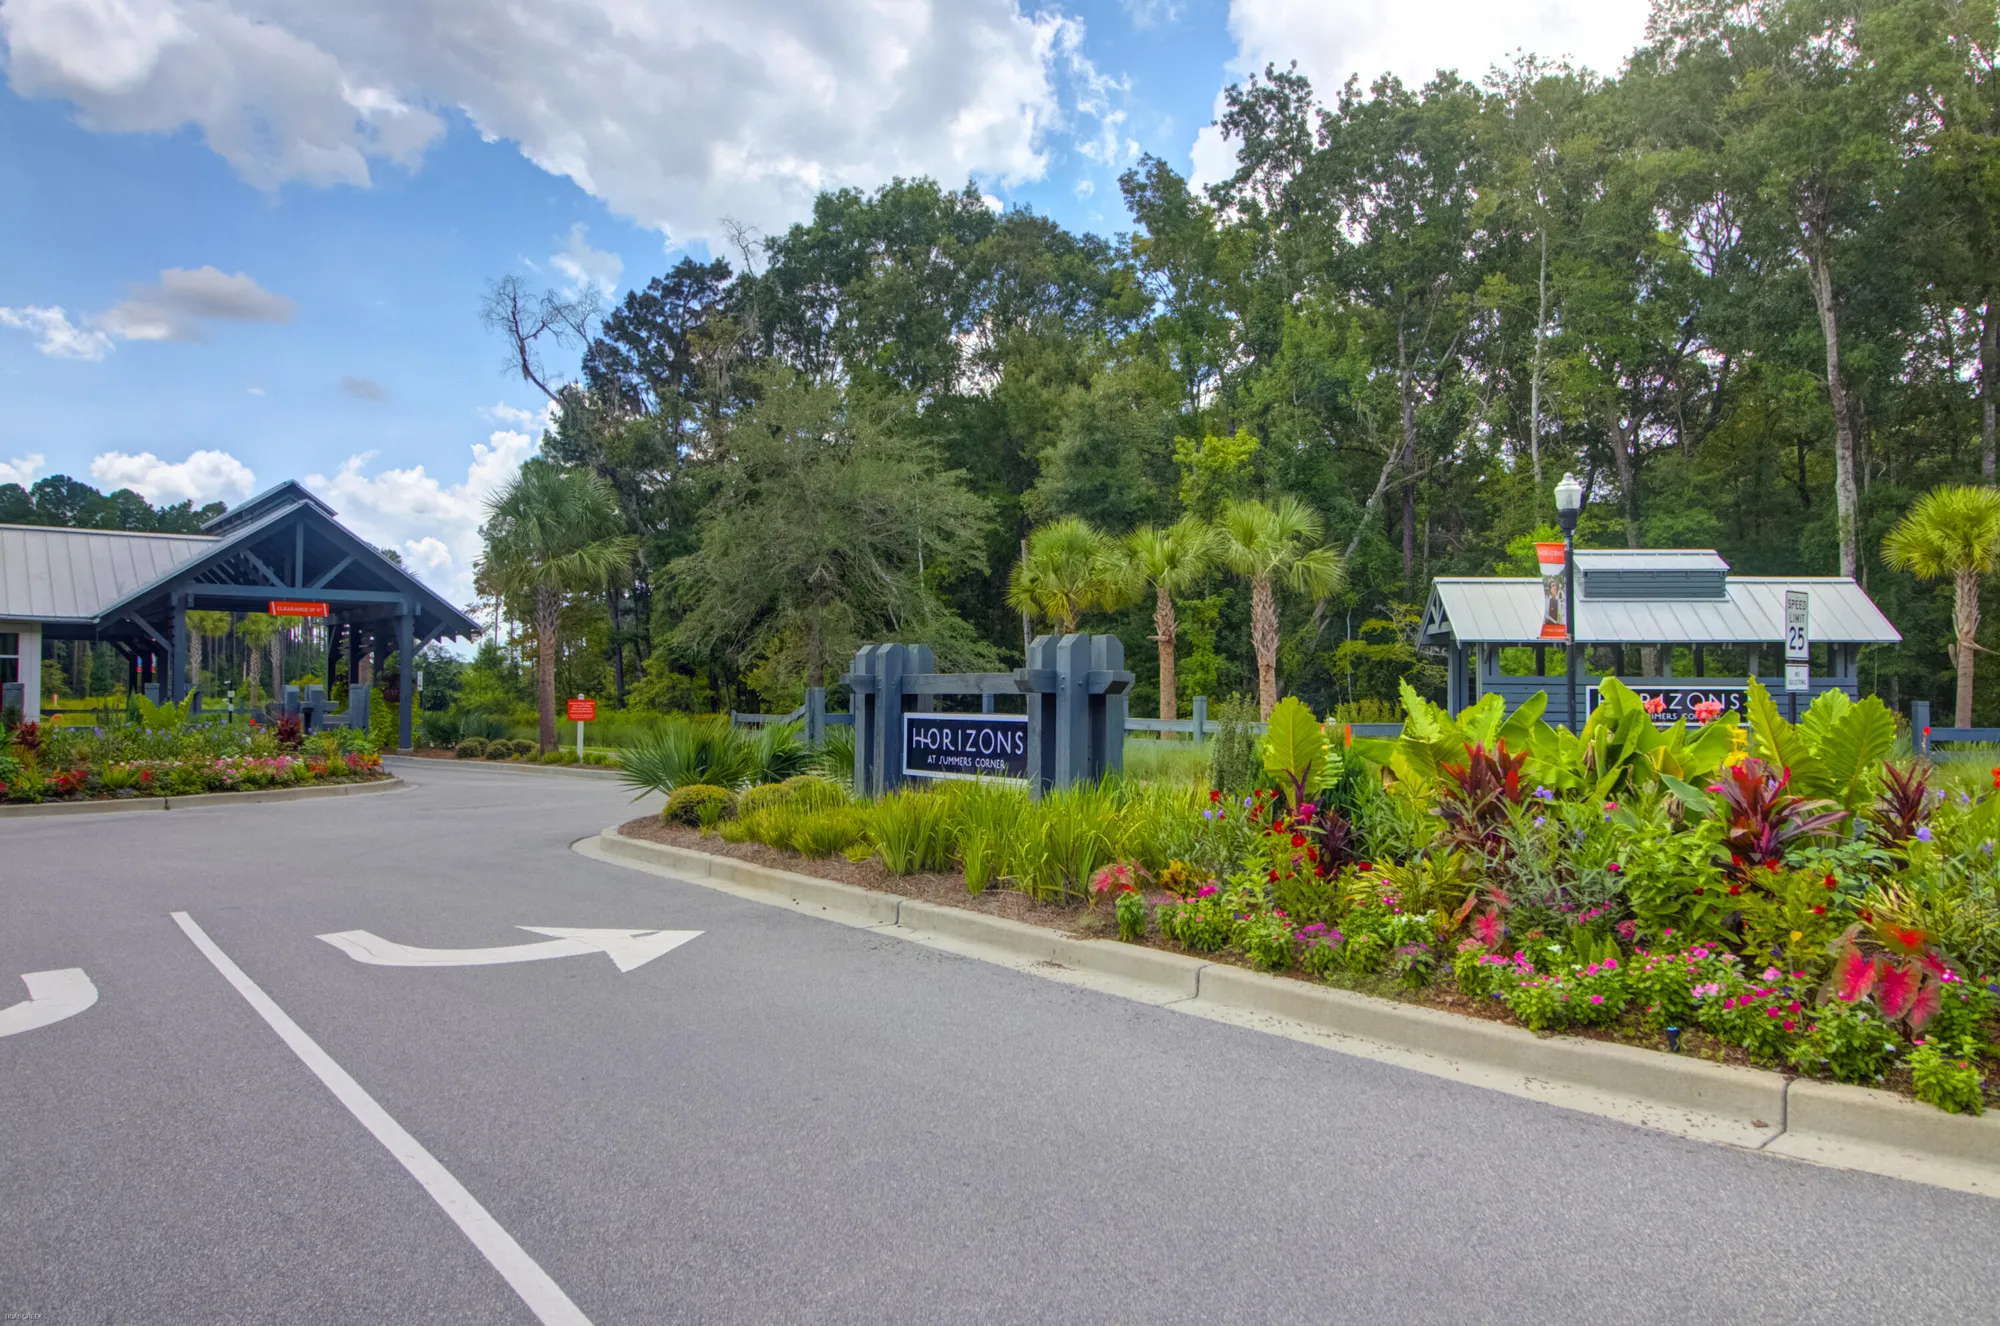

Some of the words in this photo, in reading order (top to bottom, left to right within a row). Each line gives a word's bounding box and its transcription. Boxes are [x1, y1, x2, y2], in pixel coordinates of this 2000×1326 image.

[1787, 599, 1807, 610] SPEED
[1789, 612, 1805, 624] LIMIT
[1789, 626, 1805, 650] 25
[912, 727, 1024, 755] HORIZONS
[927, 755, 937, 764] AT
[938, 755, 972, 767] SUMMERS
[975, 757, 1006, 770] CORNER
